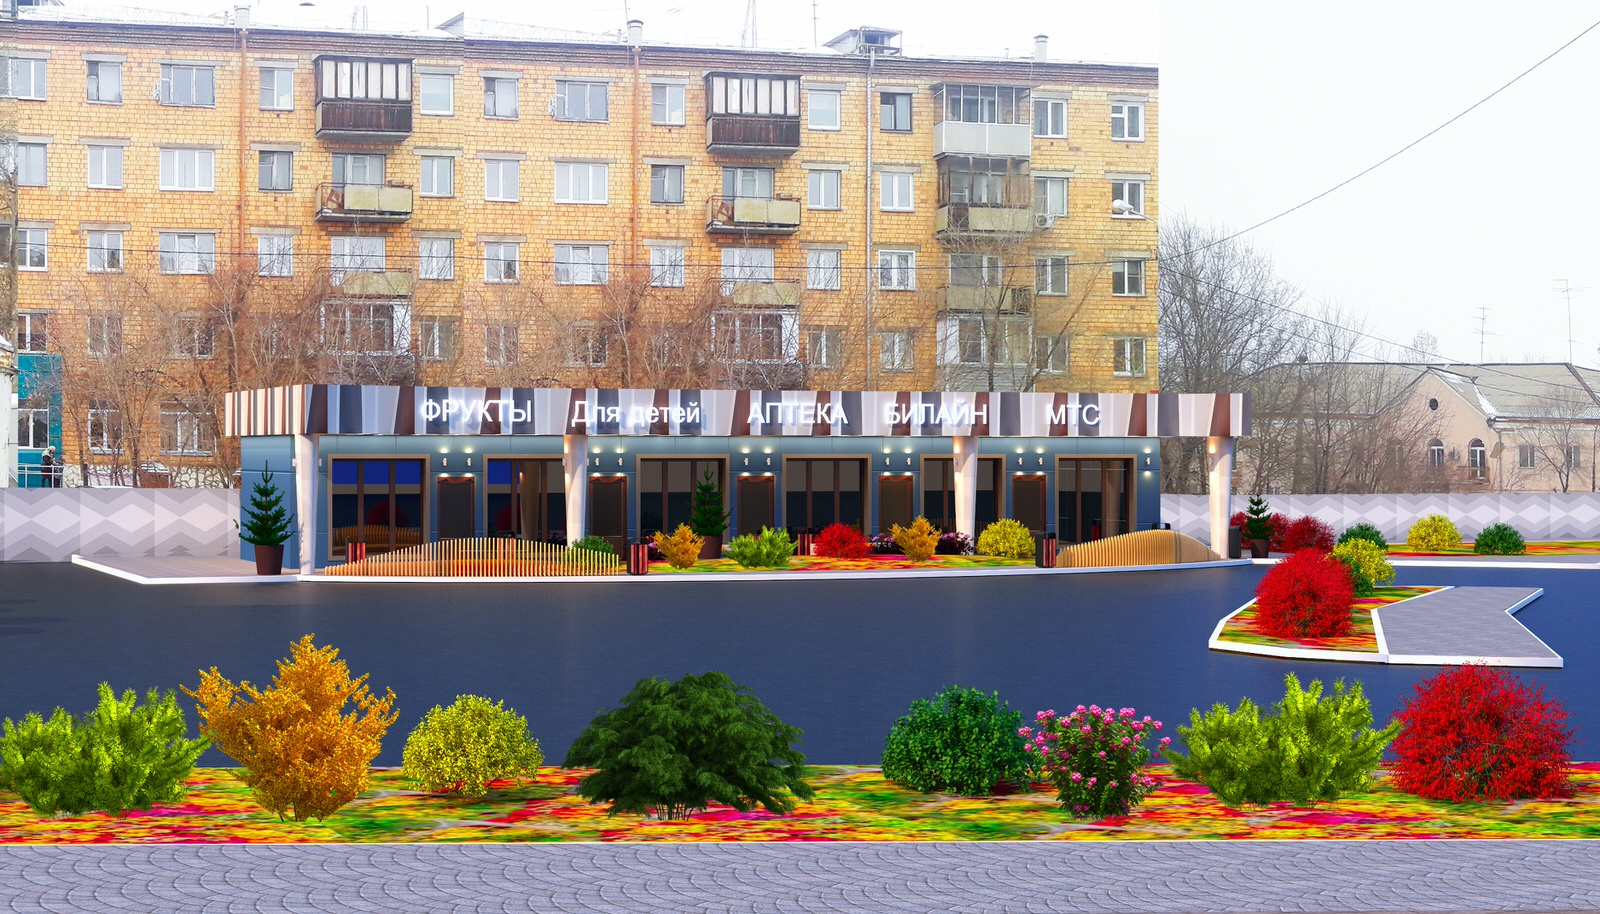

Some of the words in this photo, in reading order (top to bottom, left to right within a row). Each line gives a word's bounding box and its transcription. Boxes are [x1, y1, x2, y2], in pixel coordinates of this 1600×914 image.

[420, 398, 532, 423] ФРУКТЫ
[571, 401, 620, 427] Для
[629, 401, 700, 427] детей
[747, 402, 849, 425] АПТЕКА
[884, 400, 988, 425] БИЛАЙН
[1046, 403, 1102, 426] МТС
